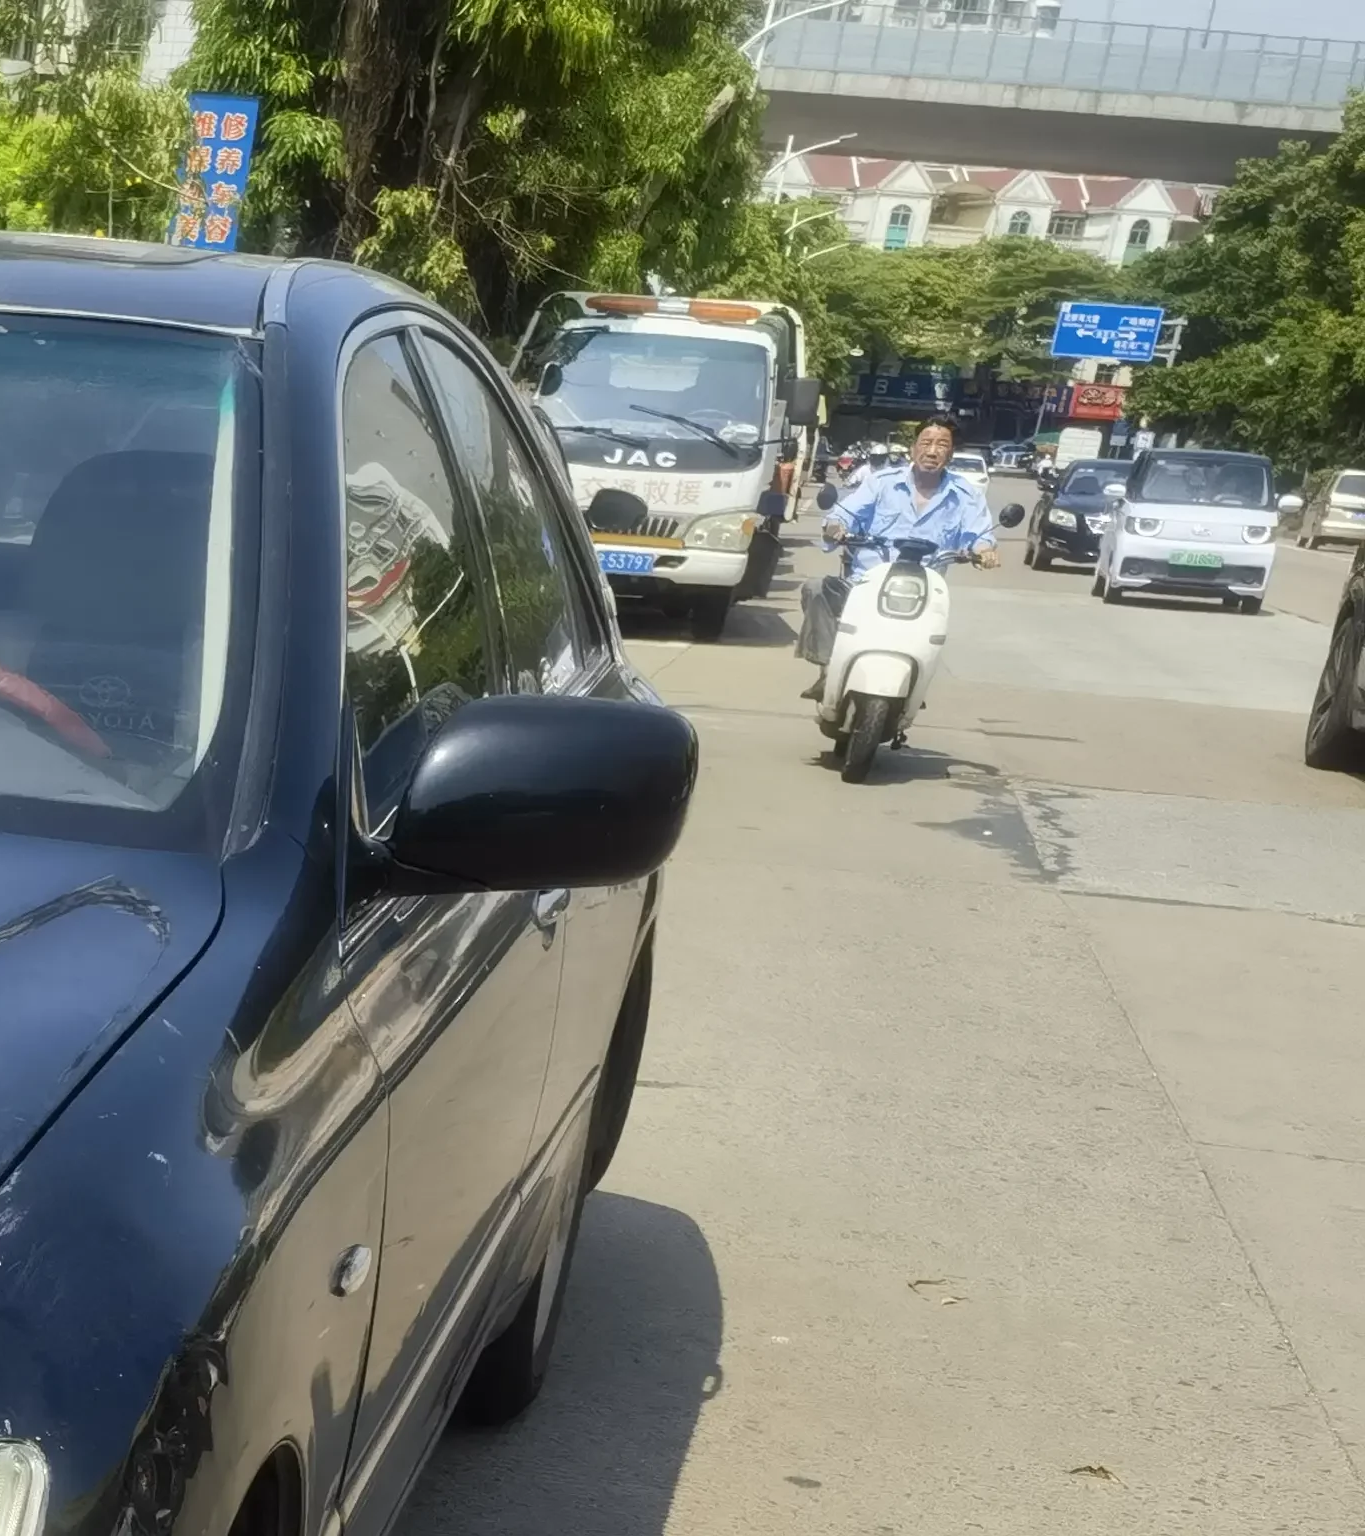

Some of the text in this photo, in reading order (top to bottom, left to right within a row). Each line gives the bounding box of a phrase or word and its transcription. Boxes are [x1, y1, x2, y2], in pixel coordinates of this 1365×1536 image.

[194, 111, 248, 140] 维修
[603, 448, 677, 468] JAC
[87, 711, 155, 731] YOTA
